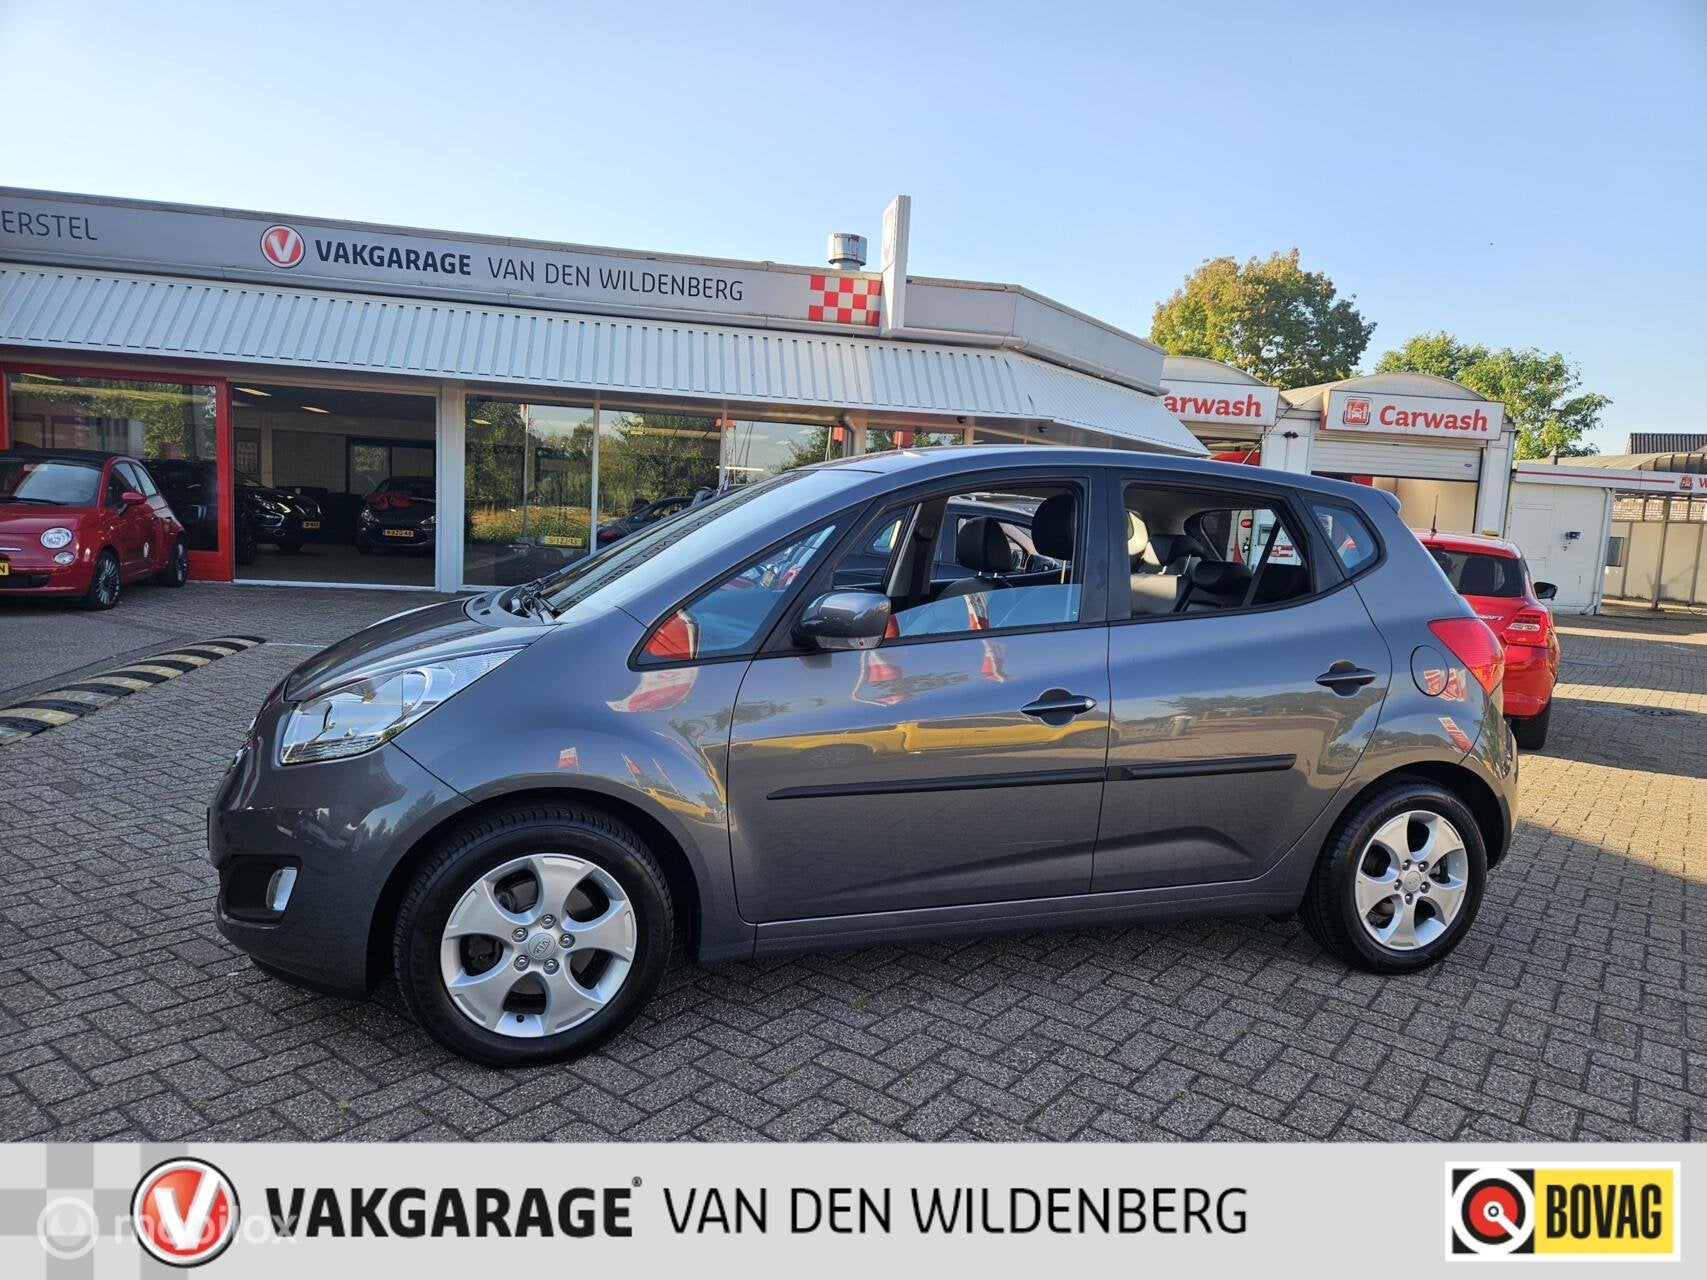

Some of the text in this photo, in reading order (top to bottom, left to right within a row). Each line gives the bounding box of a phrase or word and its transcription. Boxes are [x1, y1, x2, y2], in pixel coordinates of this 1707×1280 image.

[1, 210, 98, 241] ERSTEL
[315, 239, 744, 302] VAKGARAGE VAN DEN WILDENBERG
[1163, 393, 1263, 418] arwash
[1379, 404, 1489, 432] Carwash
